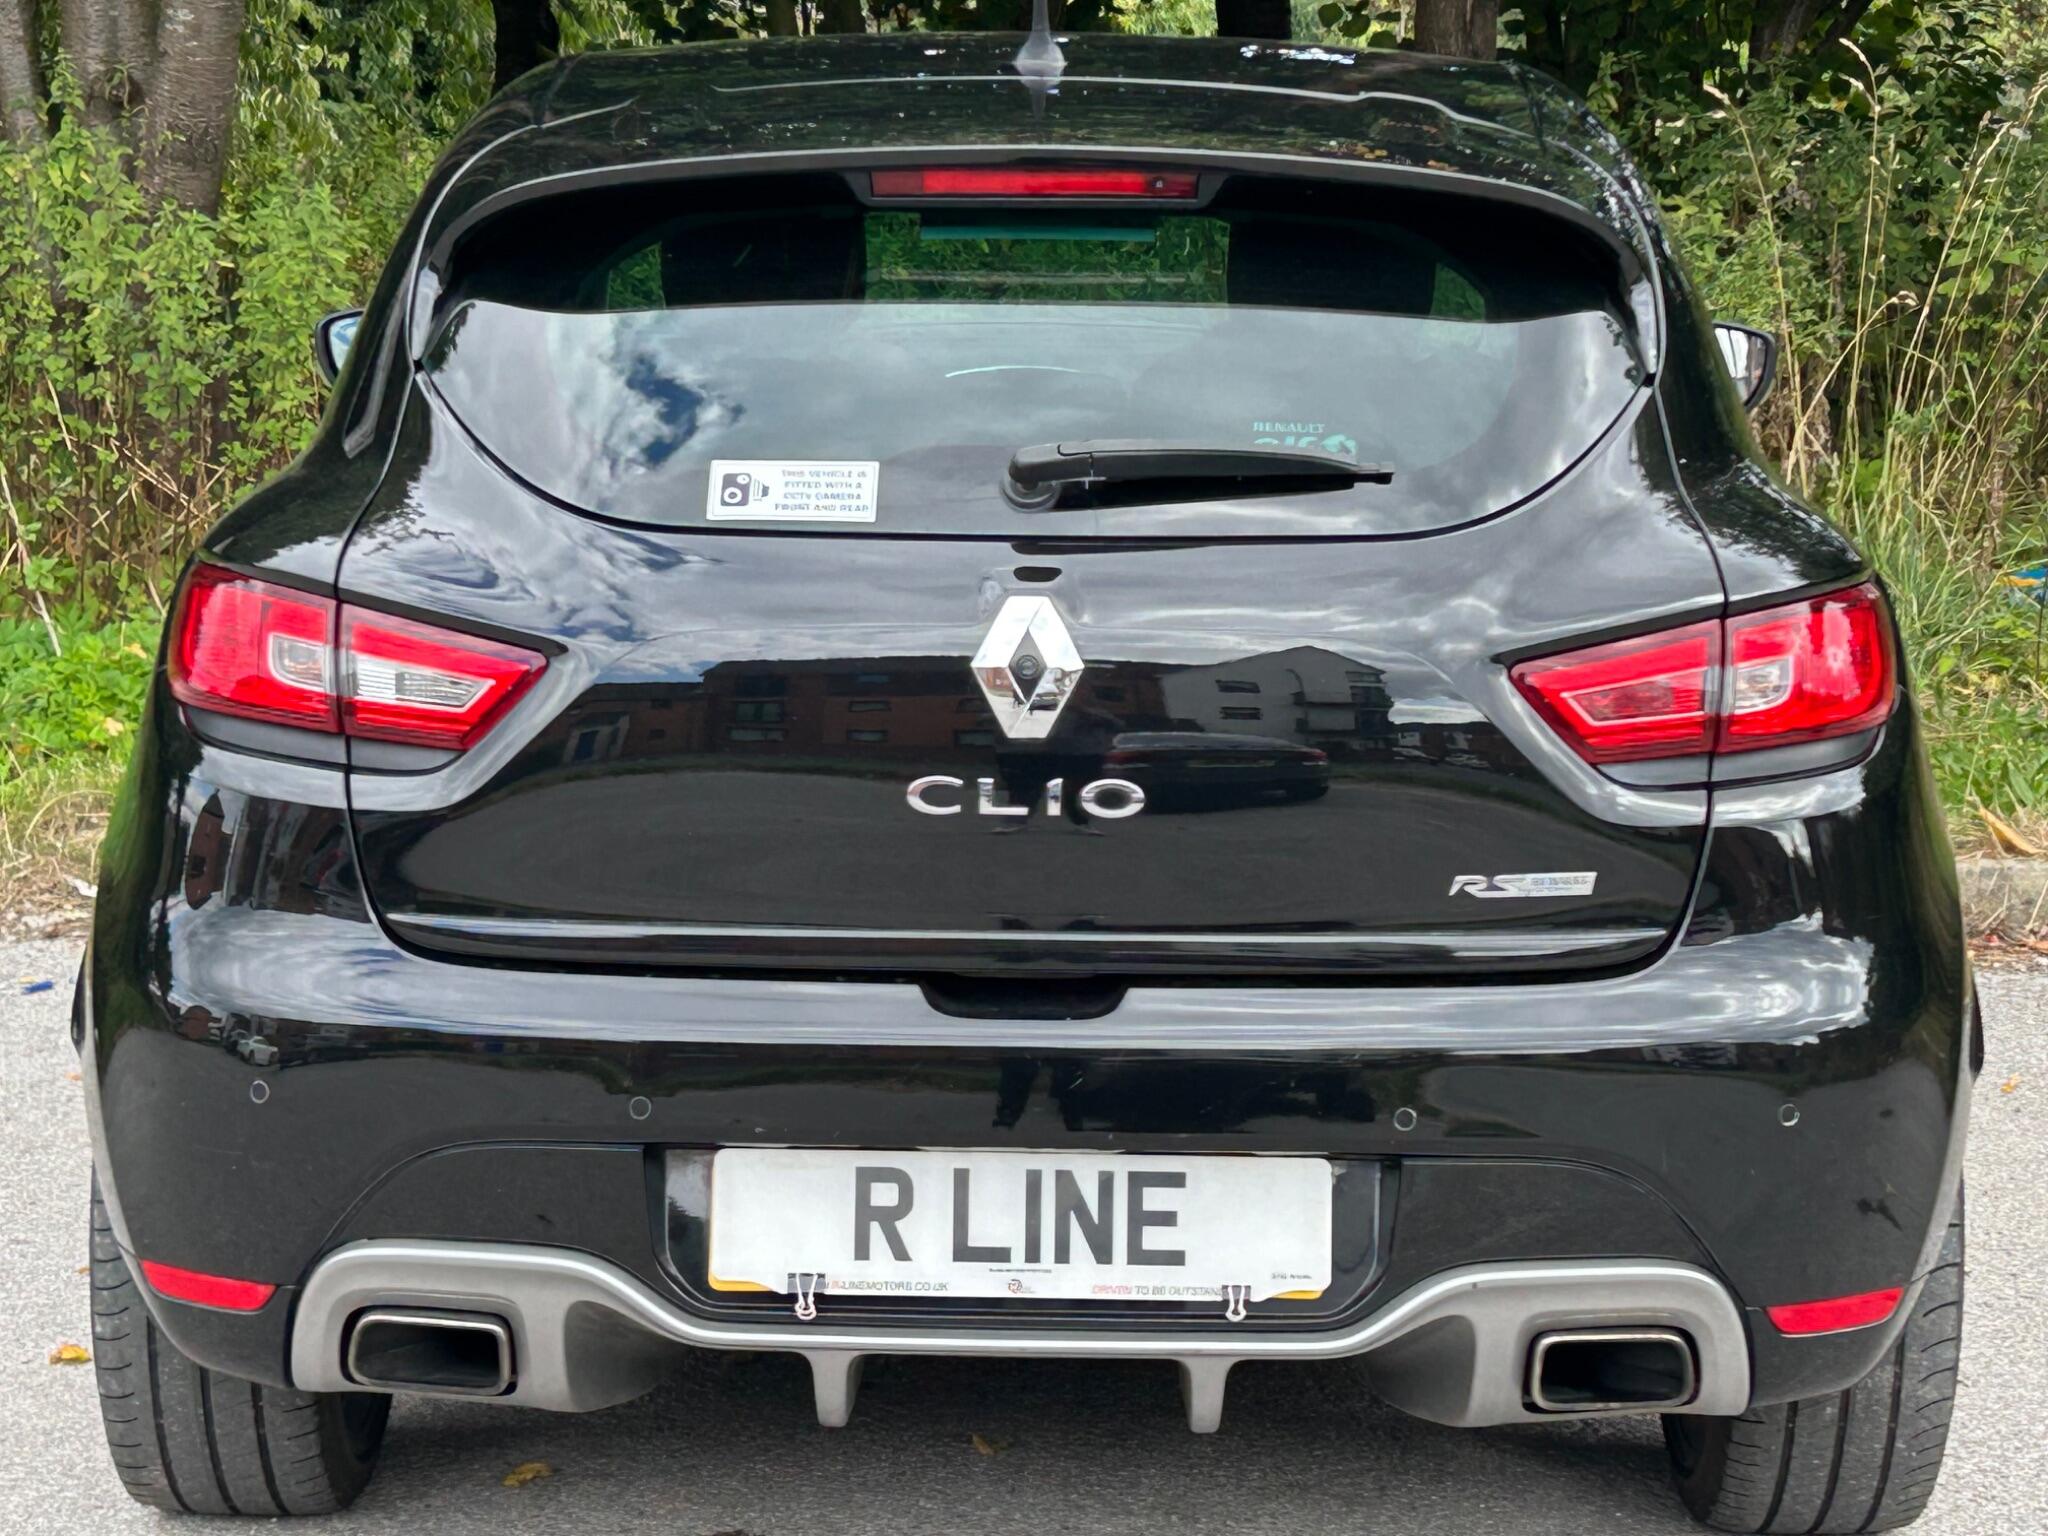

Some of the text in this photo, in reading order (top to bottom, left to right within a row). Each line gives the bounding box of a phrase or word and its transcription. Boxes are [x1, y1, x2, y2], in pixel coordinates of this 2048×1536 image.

[1253, 422, 1325, 433] RENAULT
[784, 481, 822, 489] FITTED
[784, 492, 812, 500] CCTV
[906, 775, 1145, 819] CLIO
[854, 1167, 1187, 1266] R LINE
[1135, 1285, 1149, 1295] TO
